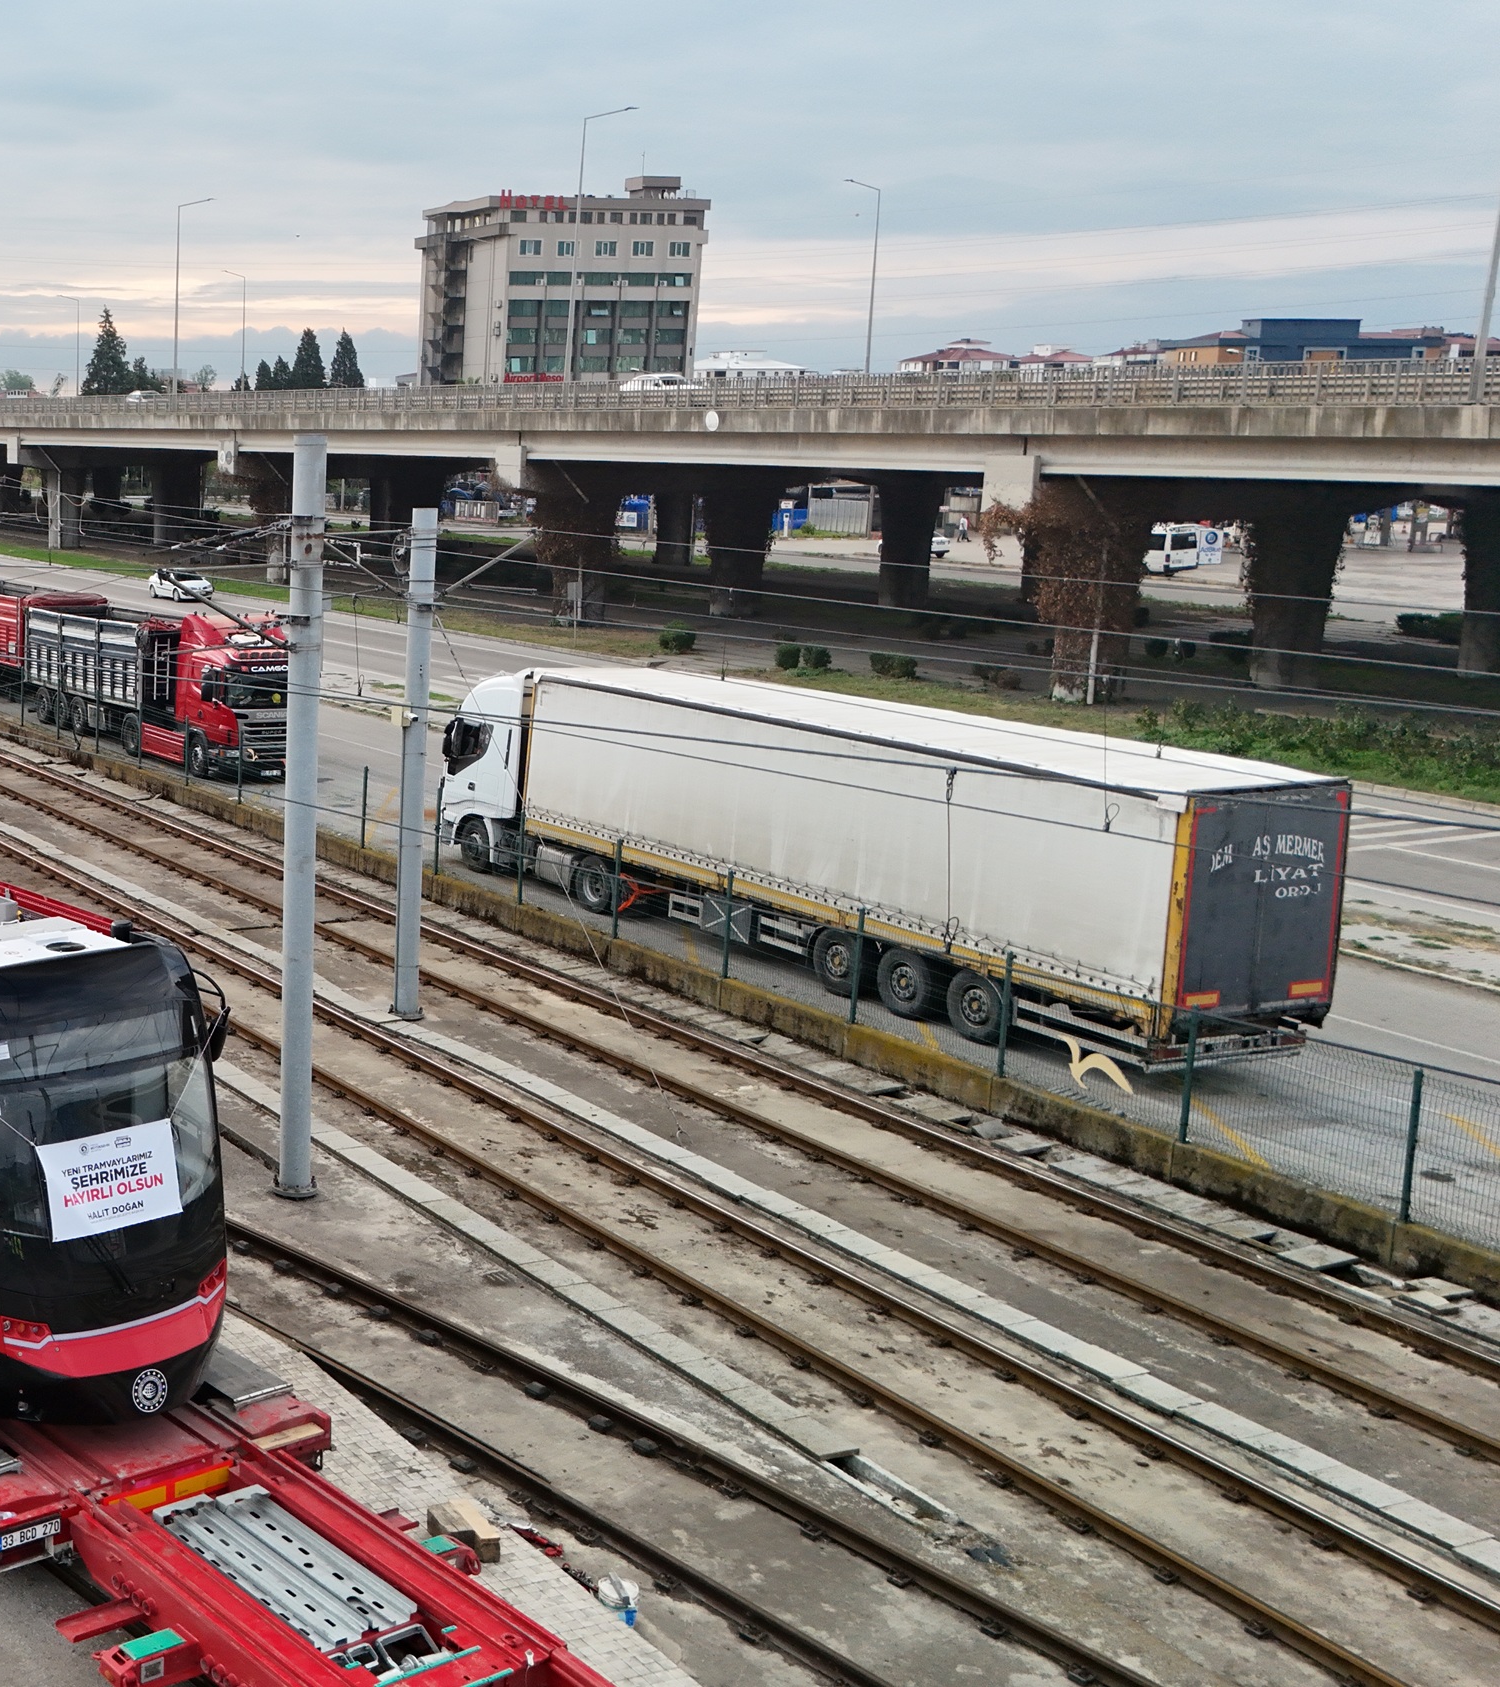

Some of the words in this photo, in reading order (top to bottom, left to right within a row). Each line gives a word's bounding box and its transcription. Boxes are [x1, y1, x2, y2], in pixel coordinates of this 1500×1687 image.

[500, 189, 568, 210] HOTEL
[83, 1151, 153, 1174] TRAMVAYLARIMIZ
[71, 1162, 148, 1191] ŞEHRİMİZE
[63, 1185, 113, 1208] HAYIRLI
[117, 1173, 163, 1195] OLSUN
[112, 1200, 144, 1215] DOĞAN
[2, 1534, 14, 1548] 33
[19, 1526, 37, 1543] BCD
[42, 1520, 60, 1536] 270
